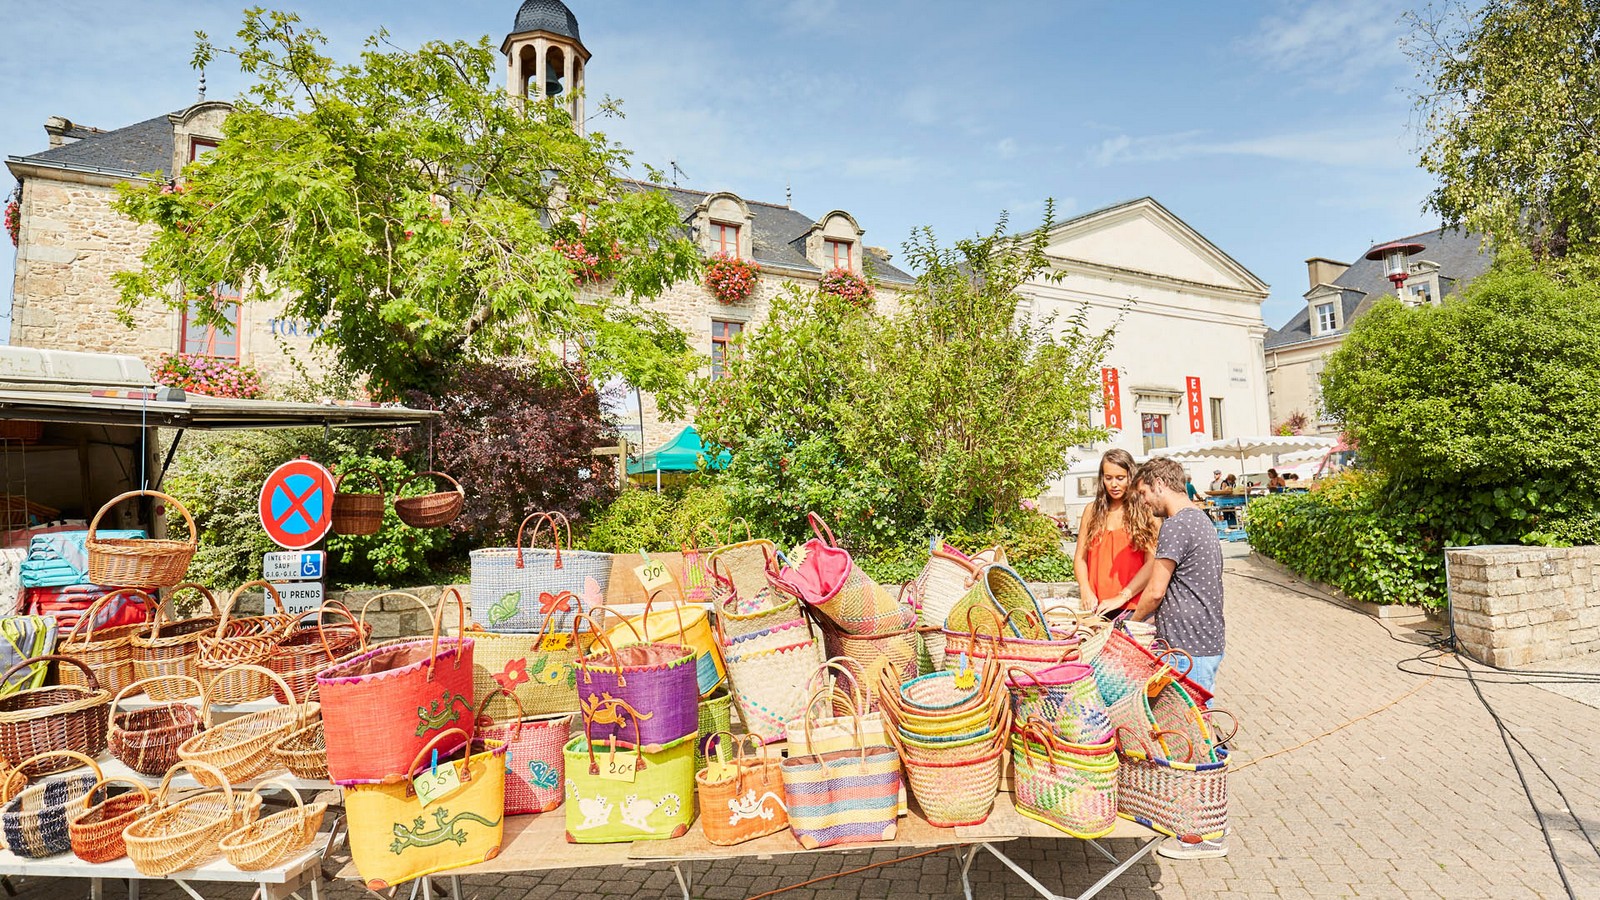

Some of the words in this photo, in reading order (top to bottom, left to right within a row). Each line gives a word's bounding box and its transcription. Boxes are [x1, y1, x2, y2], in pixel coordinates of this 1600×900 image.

[1107, 370, 1117, 425] EXPO
[1190, 378, 1200, 430] EXPO
[290, 590, 321, 599] PRENDS
